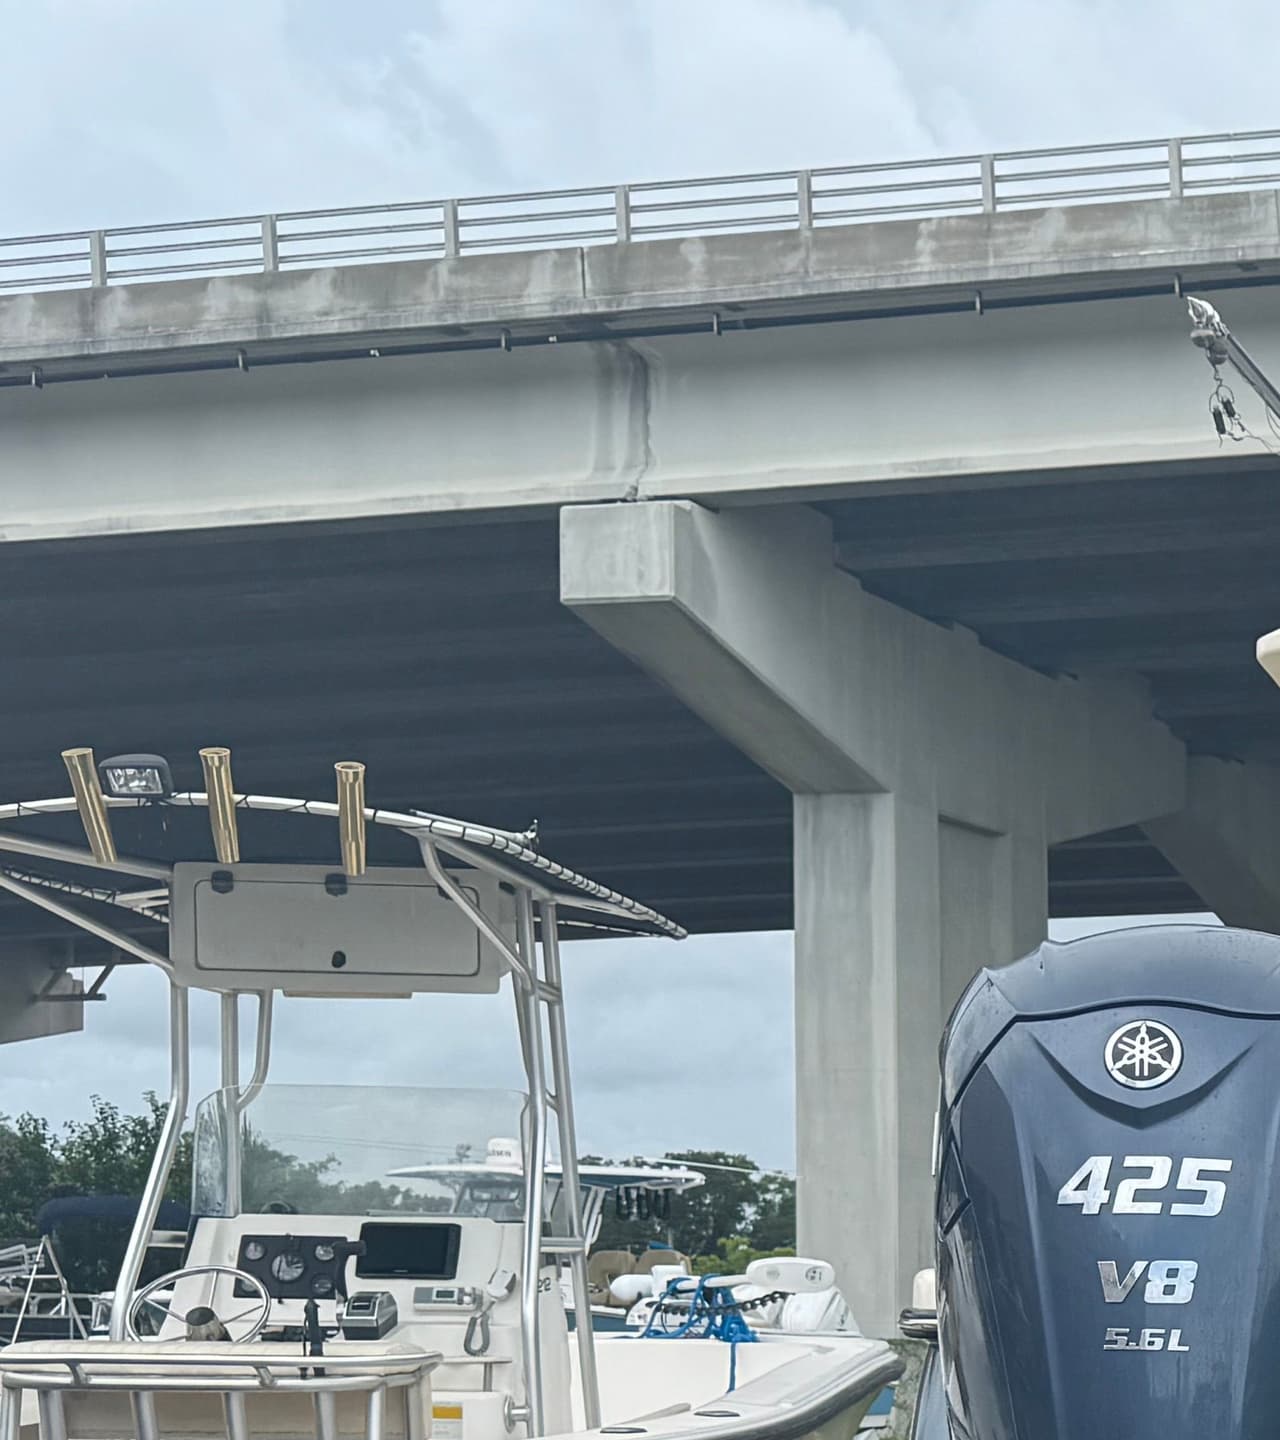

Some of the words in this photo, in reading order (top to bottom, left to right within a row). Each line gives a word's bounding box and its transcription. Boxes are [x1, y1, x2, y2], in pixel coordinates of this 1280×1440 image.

[1056, 1155, 1233, 1217] 425
[1097, 1260, 1199, 1304] V8
[1103, 1327, 1190, 1351] 5.6L
